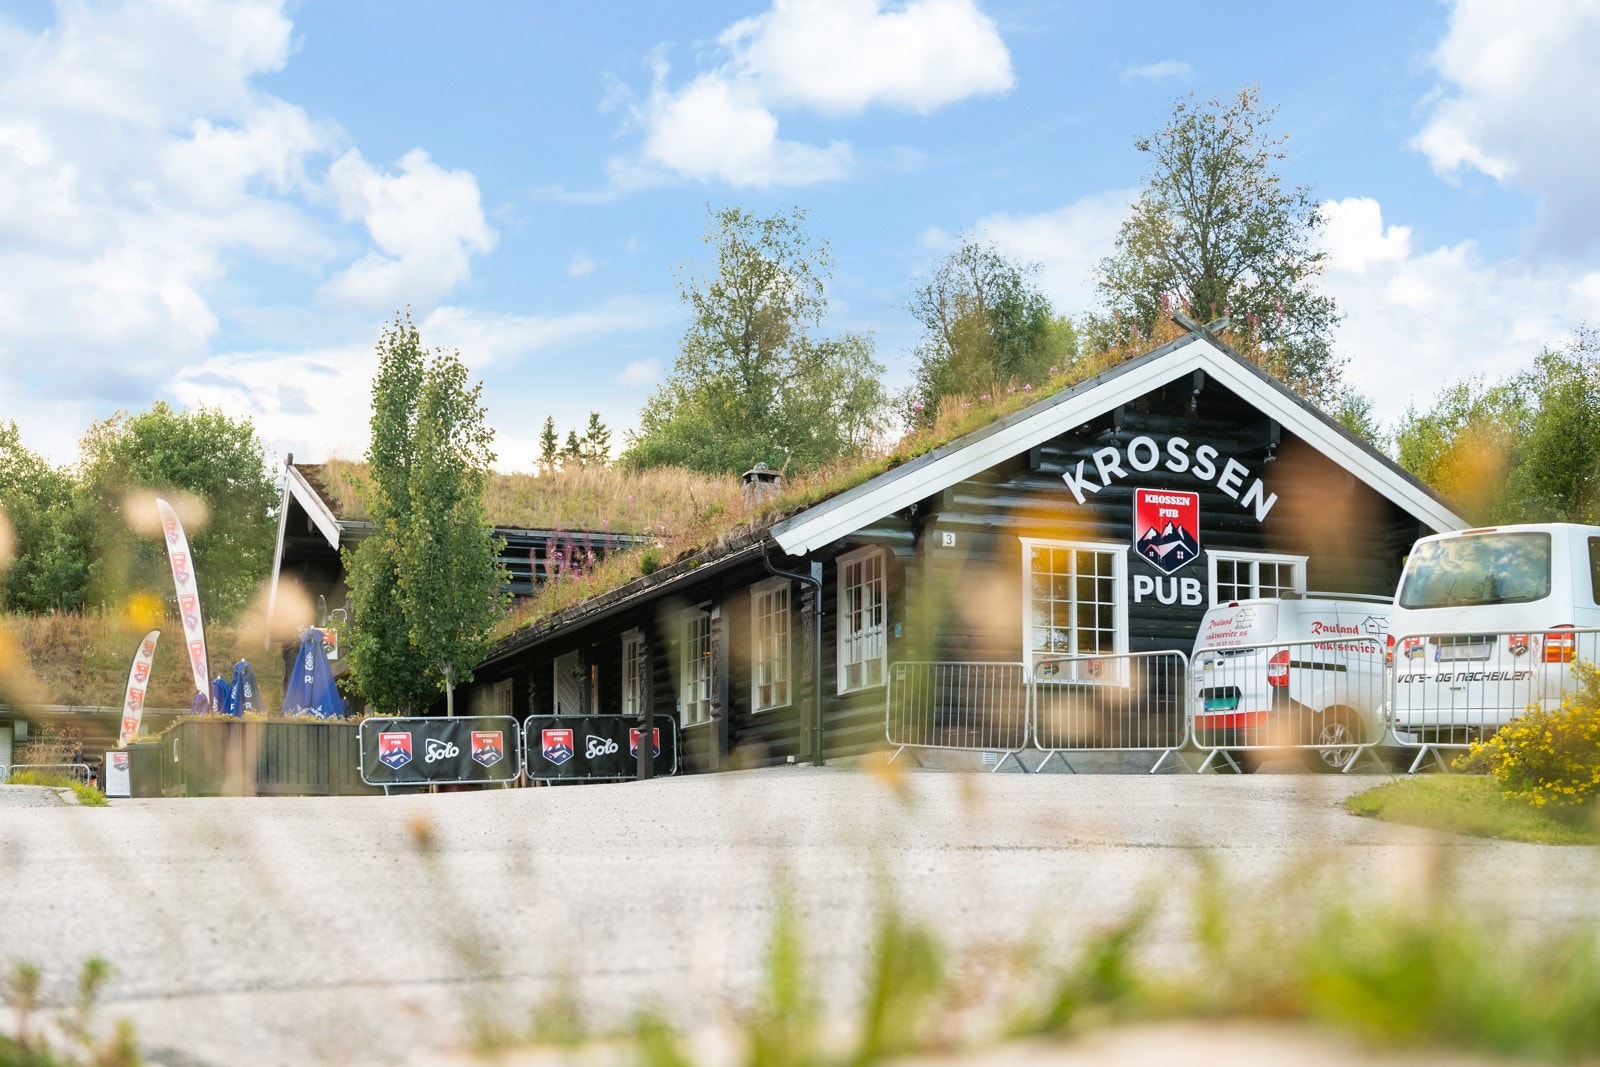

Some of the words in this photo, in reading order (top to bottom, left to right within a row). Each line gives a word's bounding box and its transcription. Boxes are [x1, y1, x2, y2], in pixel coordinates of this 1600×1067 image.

[1062, 435, 1278, 523] KROSSEN
[1144, 494, 1191, 506] KROSSEN
[1158, 508, 1179, 518] PUB
[946, 534, 952, 545] 3
[1133, 574, 1203, 606] PUB
[1311, 621, 1359, 635] Rauland
[425, 739, 460, 763] Solo
[585, 736, 619, 759] Solo
